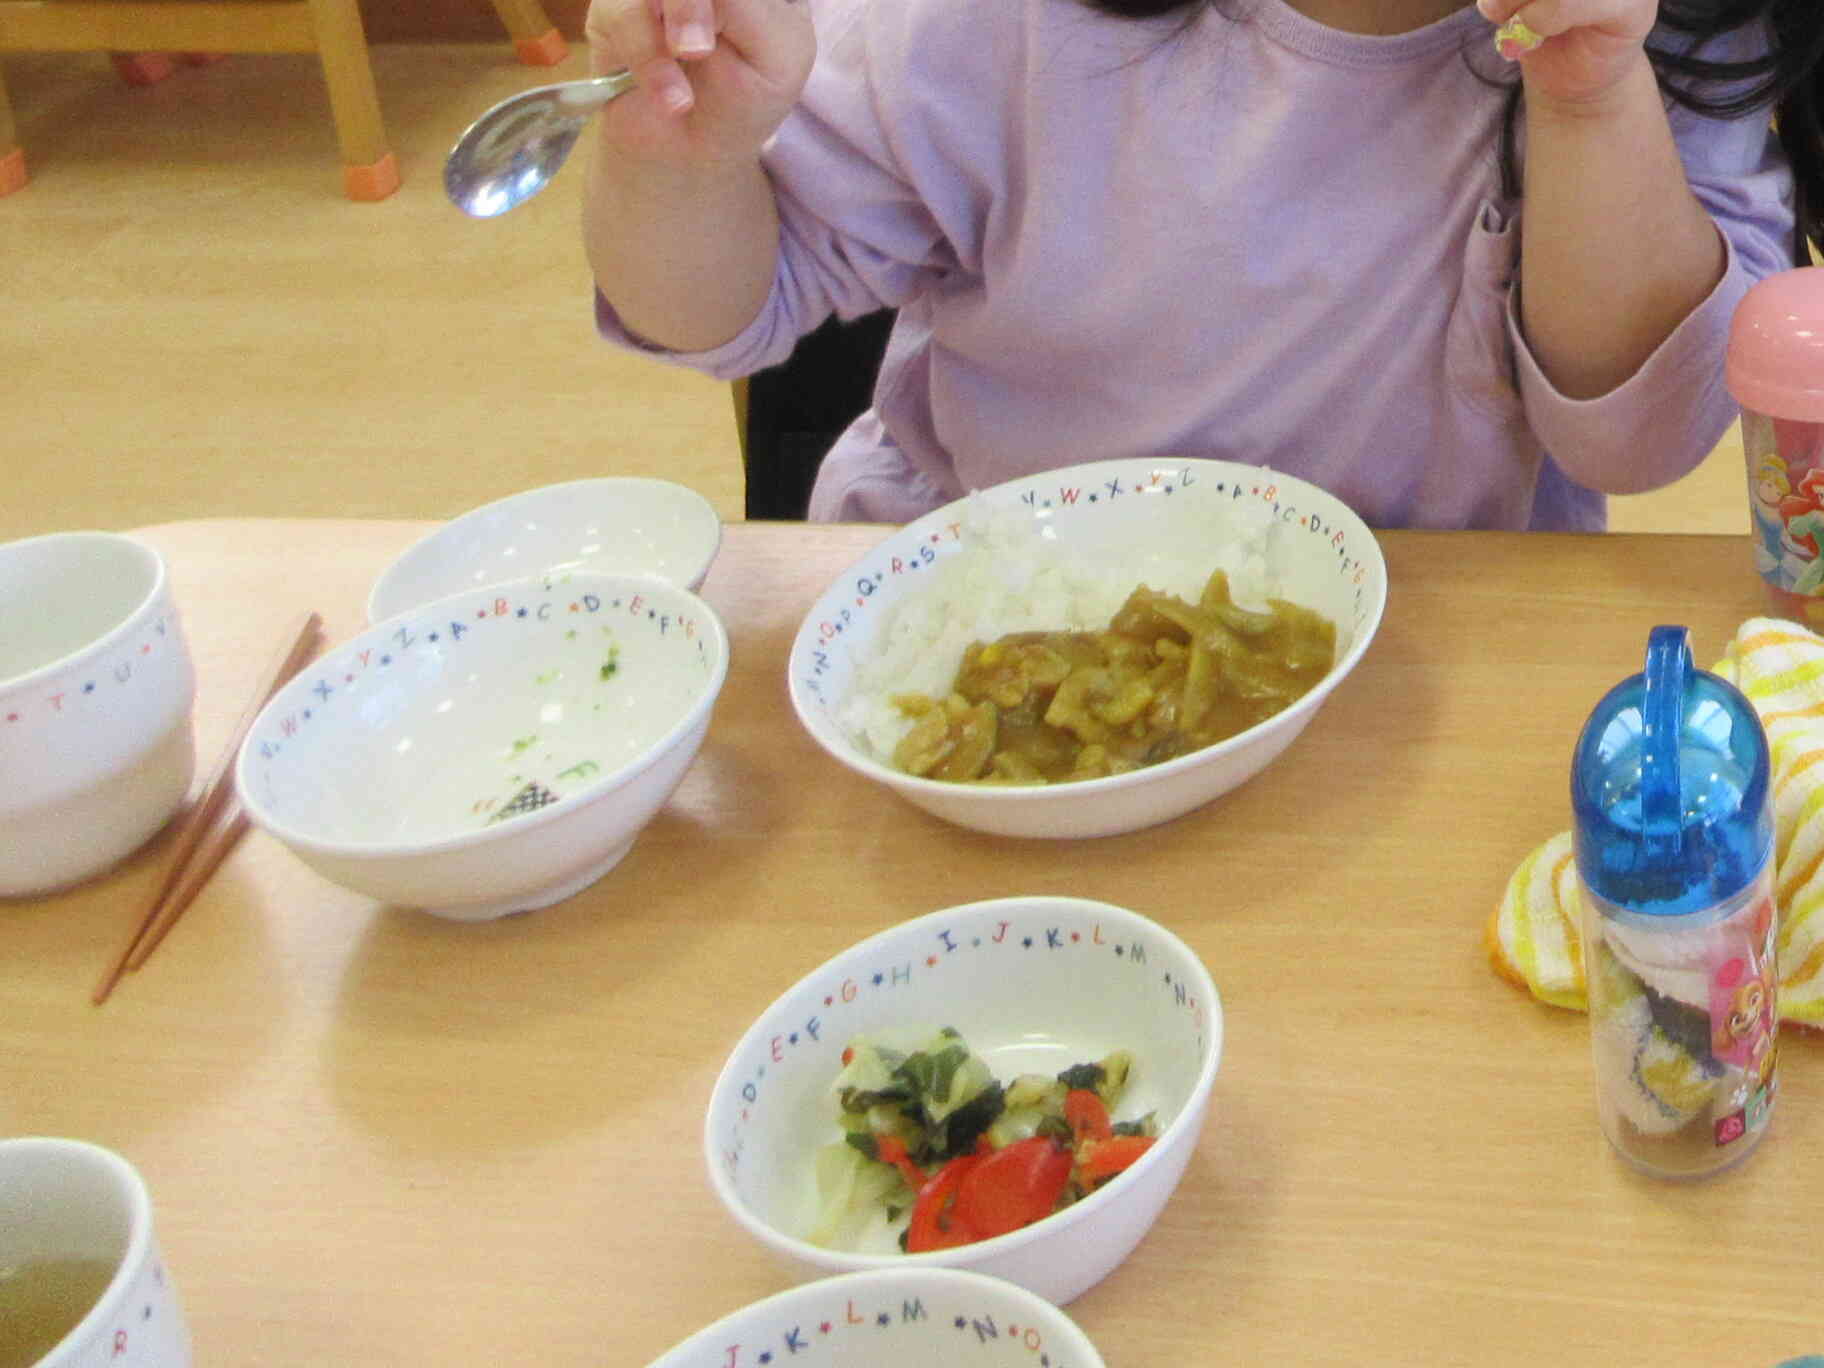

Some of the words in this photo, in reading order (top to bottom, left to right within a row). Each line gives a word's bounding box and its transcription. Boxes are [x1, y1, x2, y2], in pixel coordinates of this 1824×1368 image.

[857, 579, 877, 596] Q
[891, 558, 904, 573] R
[920, 546, 935, 564] S
[947, 523, 960, 540] T
[1060, 488, 1080, 504] W
[1105, 479, 1123, 499] X
[1150, 474, 1163, 487] Y
[1310, 514, 1320, 532] D
[312, 680, 334, 702] X
[451, 622, 467, 640] A
[494, 599, 508, 616] B
[537, 603, 552, 621] C
[582, 595, 600, 613] D
[772, 1036, 783, 1063] E
[806, 1017, 820, 1040] F
[841, 979, 858, 1003] G
[892, 963, 911, 986] H
[938, 930, 957, 952] I
[992, 921, 1009, 943] J
[1046, 928, 1063, 949] K
[1094, 925, 1105, 944] L
[1131, 943, 1146, 964] M
[1175, 984, 1186, 1005] N
[723, 1344, 740, 1368] J
[785, 1327, 808, 1354] K
[848, 1300, 864, 1324] L
[902, 1298, 926, 1322] M
[972, 1315, 998, 1344] N
[1024, 1328, 1041, 1351] O
